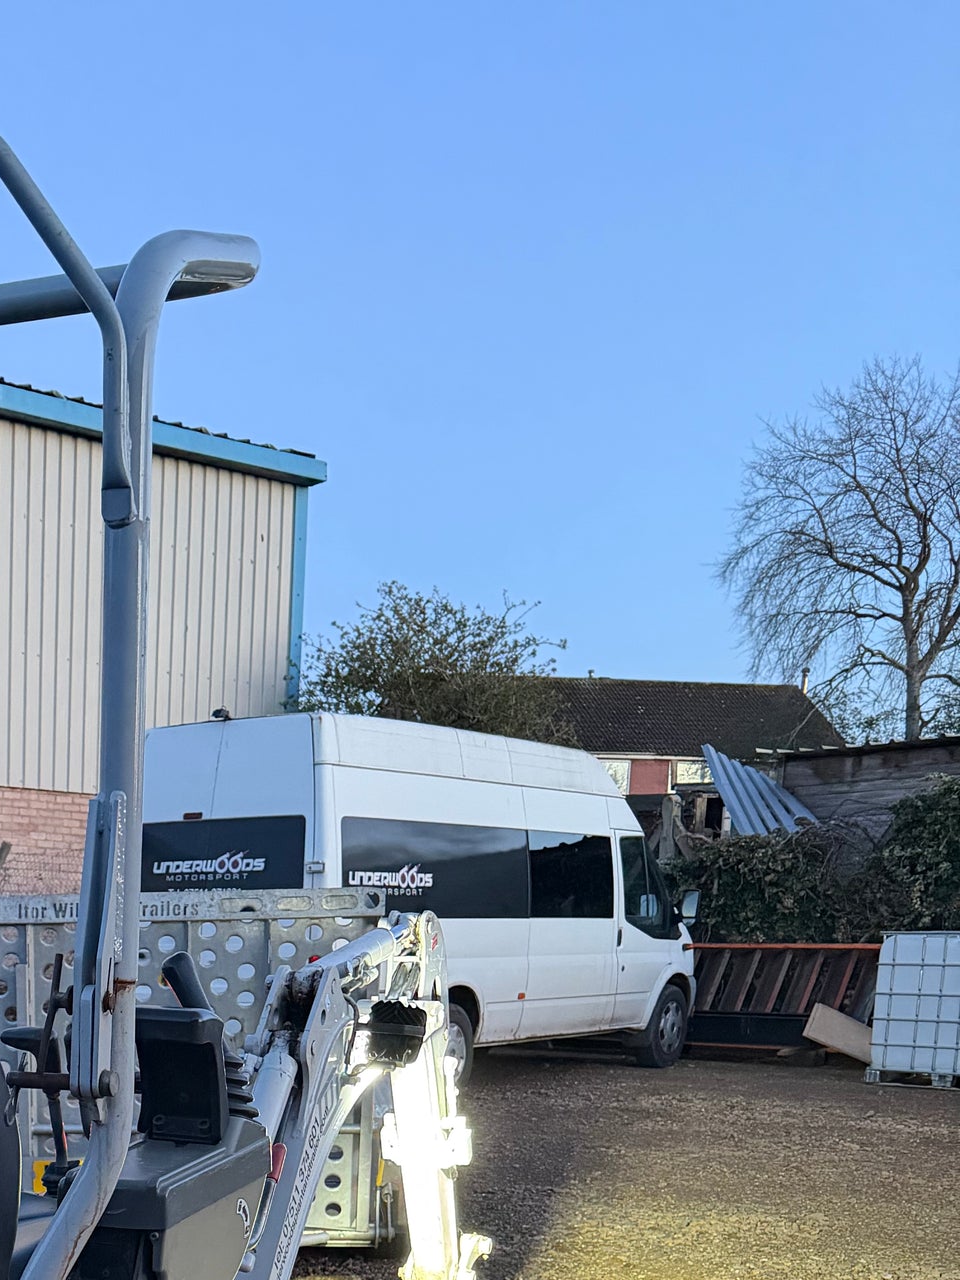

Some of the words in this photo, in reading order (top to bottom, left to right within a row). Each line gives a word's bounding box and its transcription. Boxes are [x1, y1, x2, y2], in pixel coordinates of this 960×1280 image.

[165, 873, 249, 882] MOTORSPORT
[139, 900, 199, 917] railers
[298, 1150, 311, 1182] 374
[308, 1116, 320, 1149] 601
